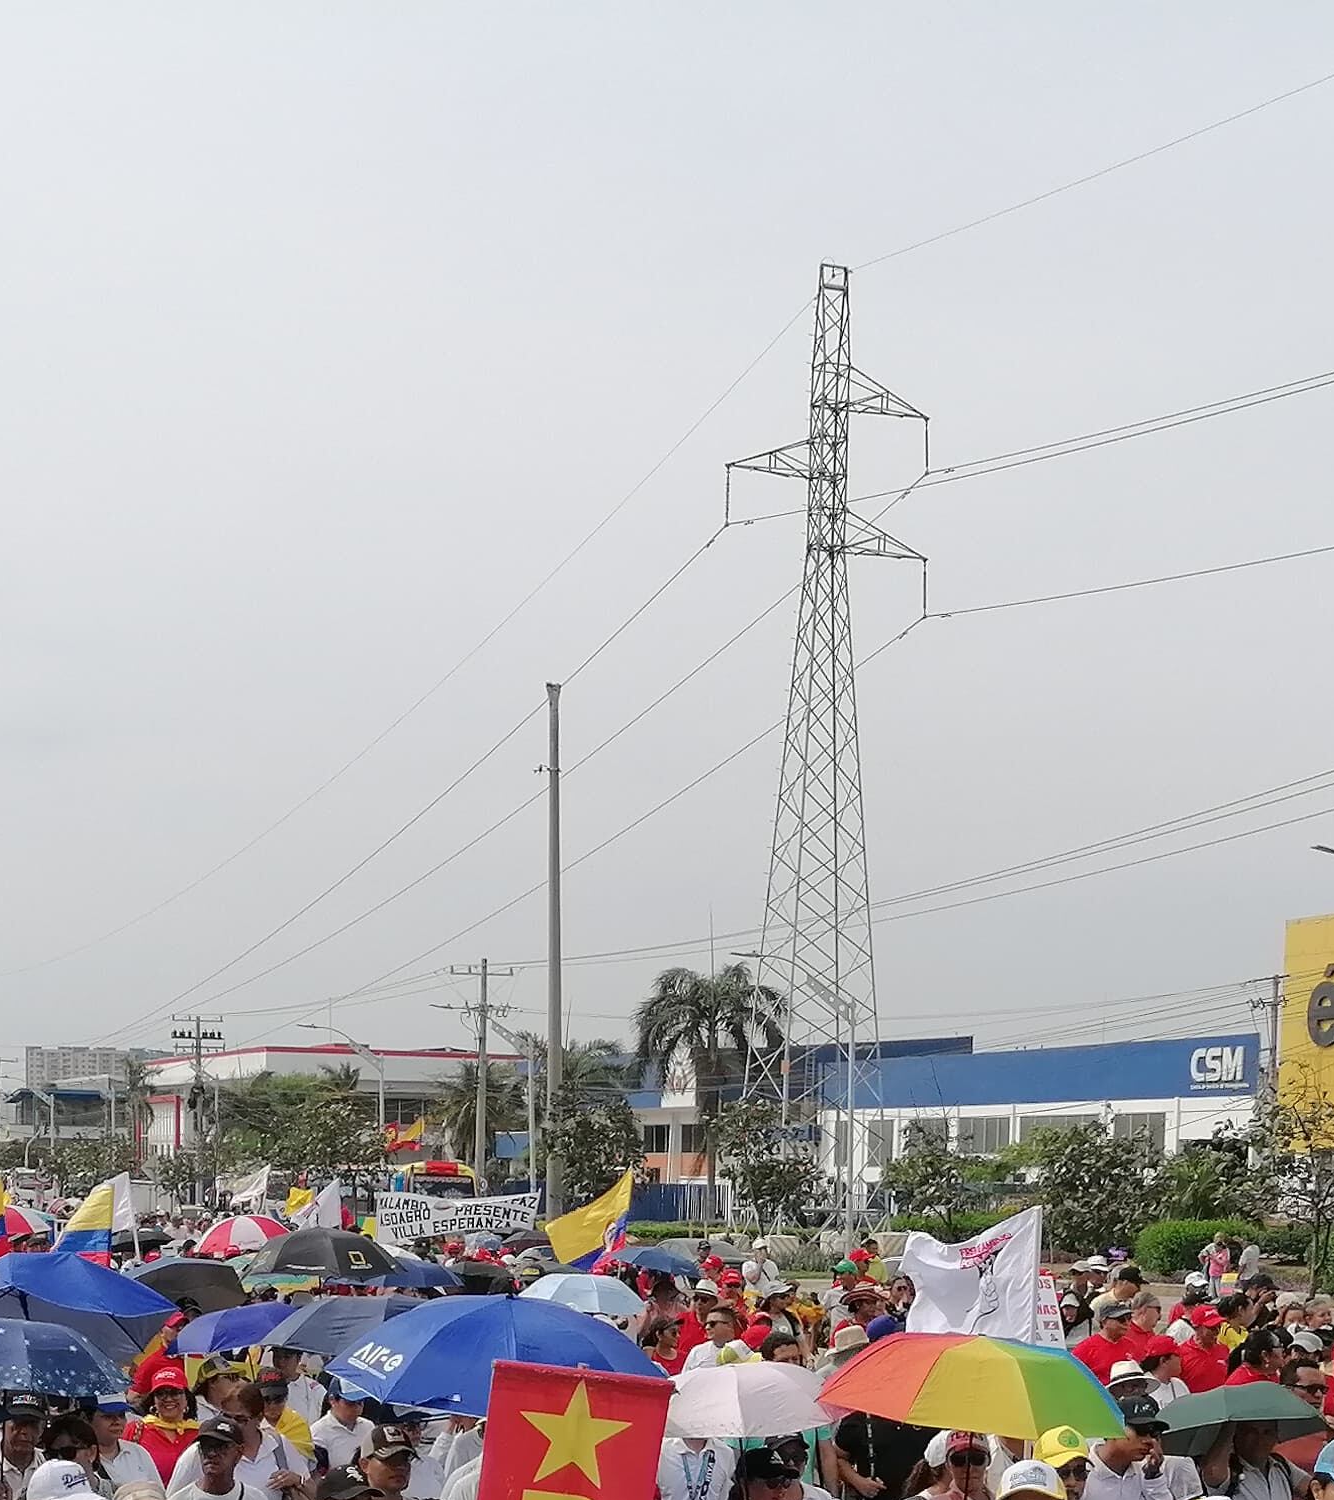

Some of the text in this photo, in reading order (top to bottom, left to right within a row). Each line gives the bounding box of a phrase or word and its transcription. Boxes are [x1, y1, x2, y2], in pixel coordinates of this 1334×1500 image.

[1190, 1046, 1244, 1082] CSM
[454, 1204, 530, 1224] PRESENTE
[391, 1217, 511, 1240] VILLA ESPERANZA
